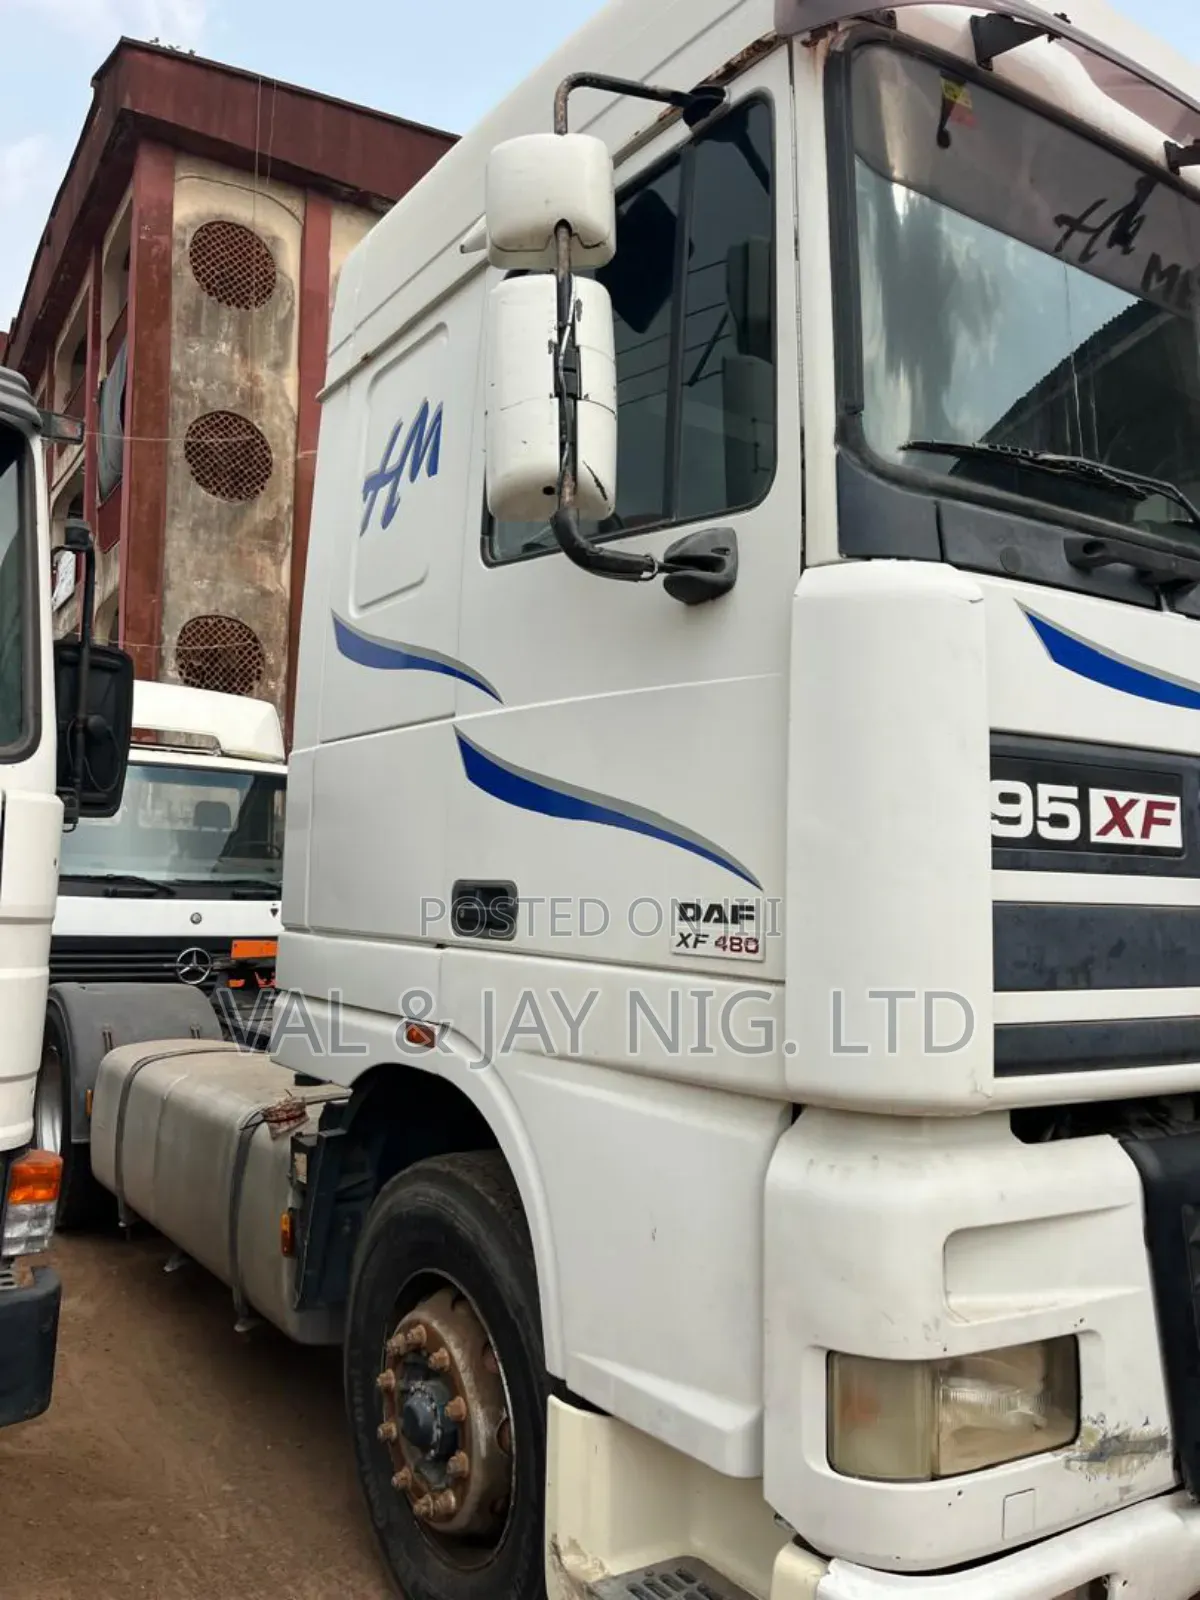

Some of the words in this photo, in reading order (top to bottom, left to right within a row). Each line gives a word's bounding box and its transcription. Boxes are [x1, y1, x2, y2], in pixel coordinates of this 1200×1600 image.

[359, 397, 444, 538] HM
[990, 779, 1081, 841] 95
[1095, 795, 1176, 839] XF
[678, 902, 756, 924] DAF
[675, 931, 710, 949] XF
[714, 934, 760, 955] 480
